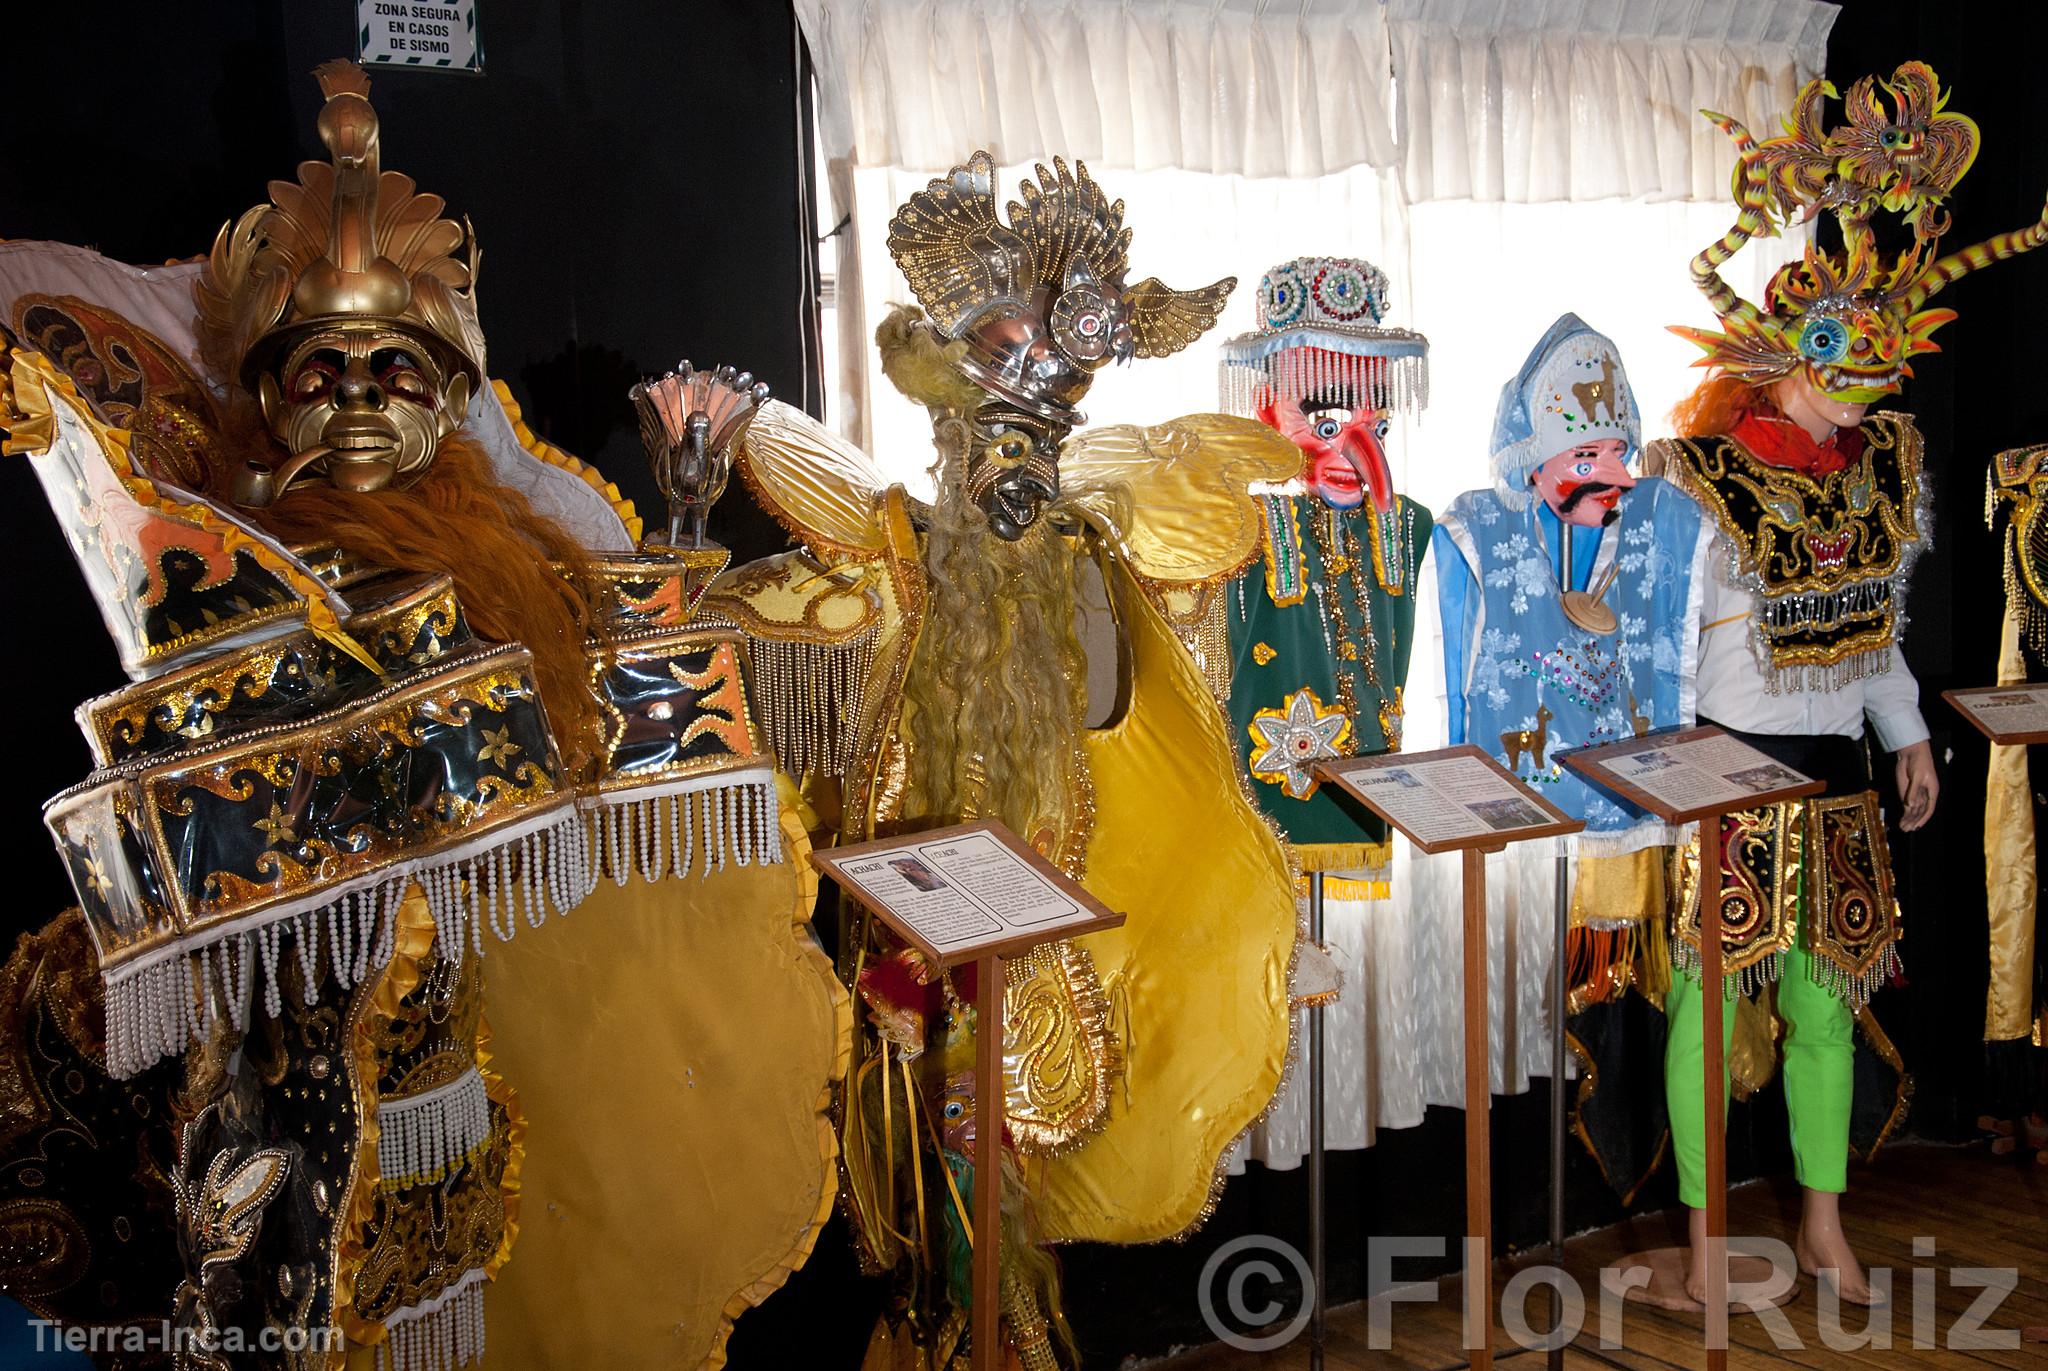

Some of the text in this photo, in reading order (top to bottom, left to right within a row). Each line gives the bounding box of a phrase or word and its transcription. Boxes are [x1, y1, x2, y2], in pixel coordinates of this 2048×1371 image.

[375, 3, 460, 22] ZONA SEGURA
[389, 21, 449, 37] EN CASOS
[390, 38, 449, 54] DE SISMO
